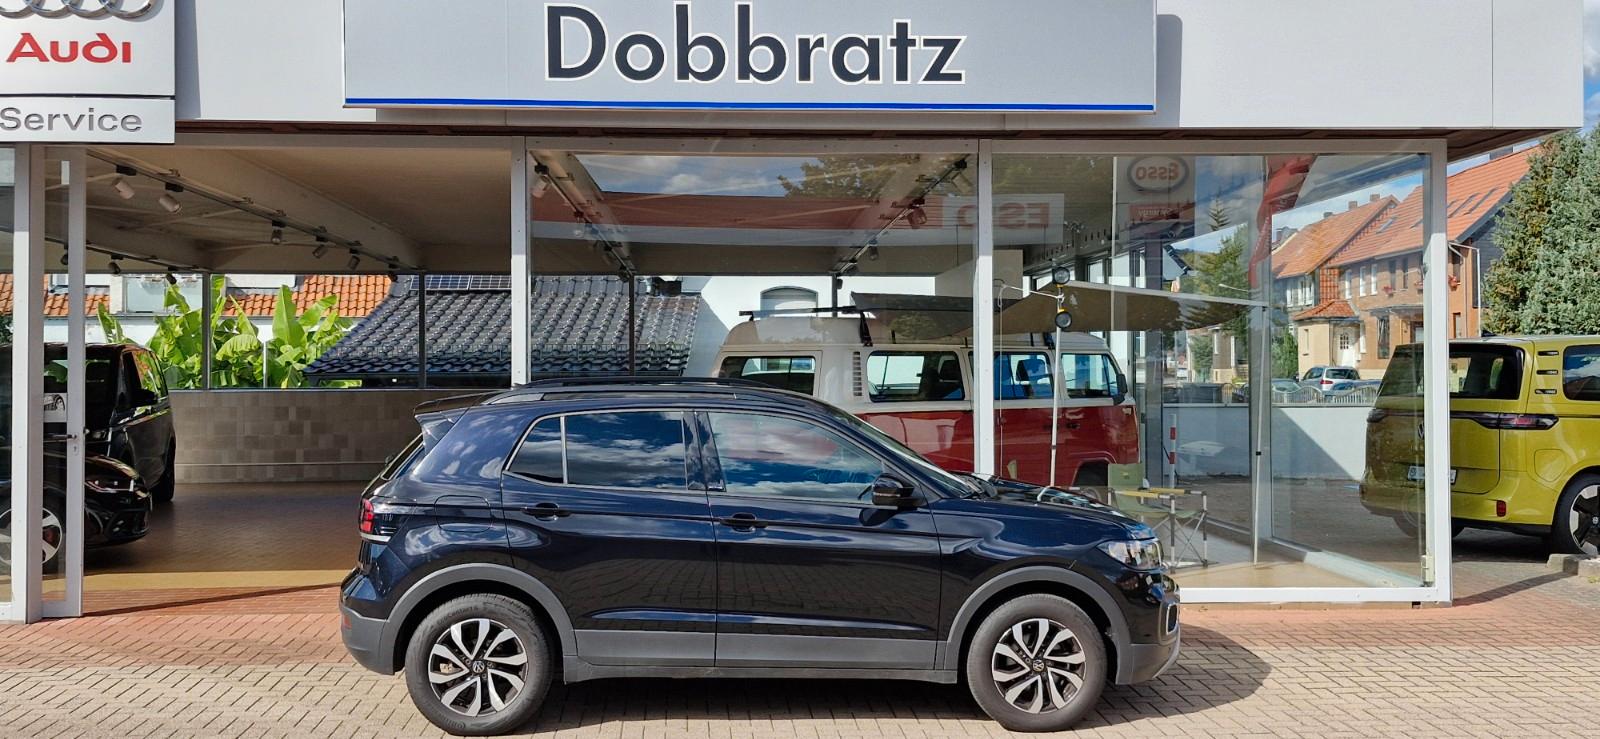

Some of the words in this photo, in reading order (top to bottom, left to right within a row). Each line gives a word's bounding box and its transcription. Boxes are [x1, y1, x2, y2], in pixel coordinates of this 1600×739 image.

[6, 33, 131, 63] Audi
[545, 1, 967, 84] Dobbratz
[0, 107, 142, 132] Service
